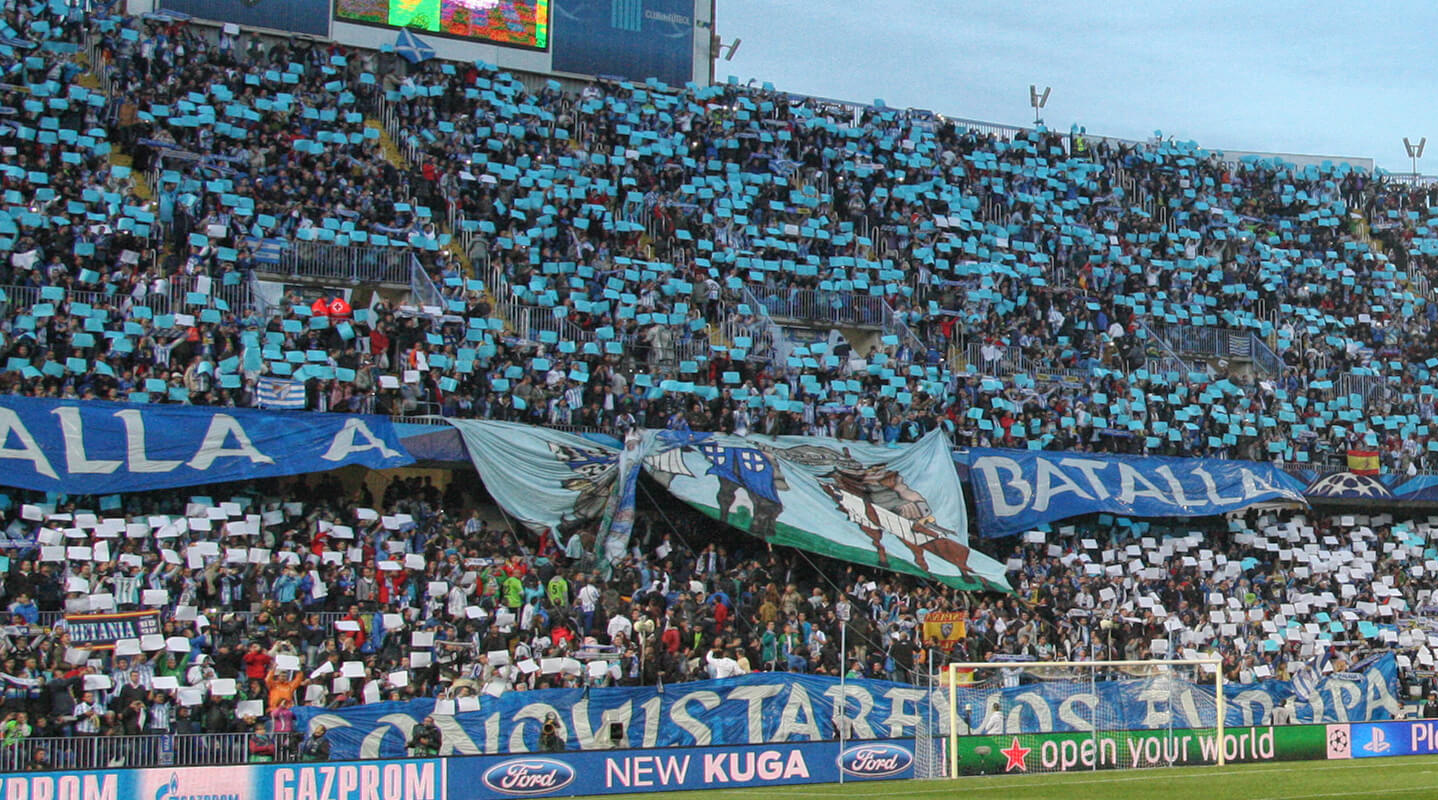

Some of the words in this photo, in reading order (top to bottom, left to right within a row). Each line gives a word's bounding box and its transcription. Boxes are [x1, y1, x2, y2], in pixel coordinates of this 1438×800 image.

[321, 418, 402, 461] A
[973, 456, 1308, 516] BATALLA
[69, 621, 136, 642] BETANIA
[851, 749, 898, 771] Ford
[1041, 737, 1117, 771] open
[1127, 735, 1192, 768] your
[1199, 727, 1275, 762] world
[274, 762, 435, 800] GAZPROM
[501, 764, 556, 789] Ford
[605, 755, 690, 787] NEW
[704, 750, 810, 783] KUGA
